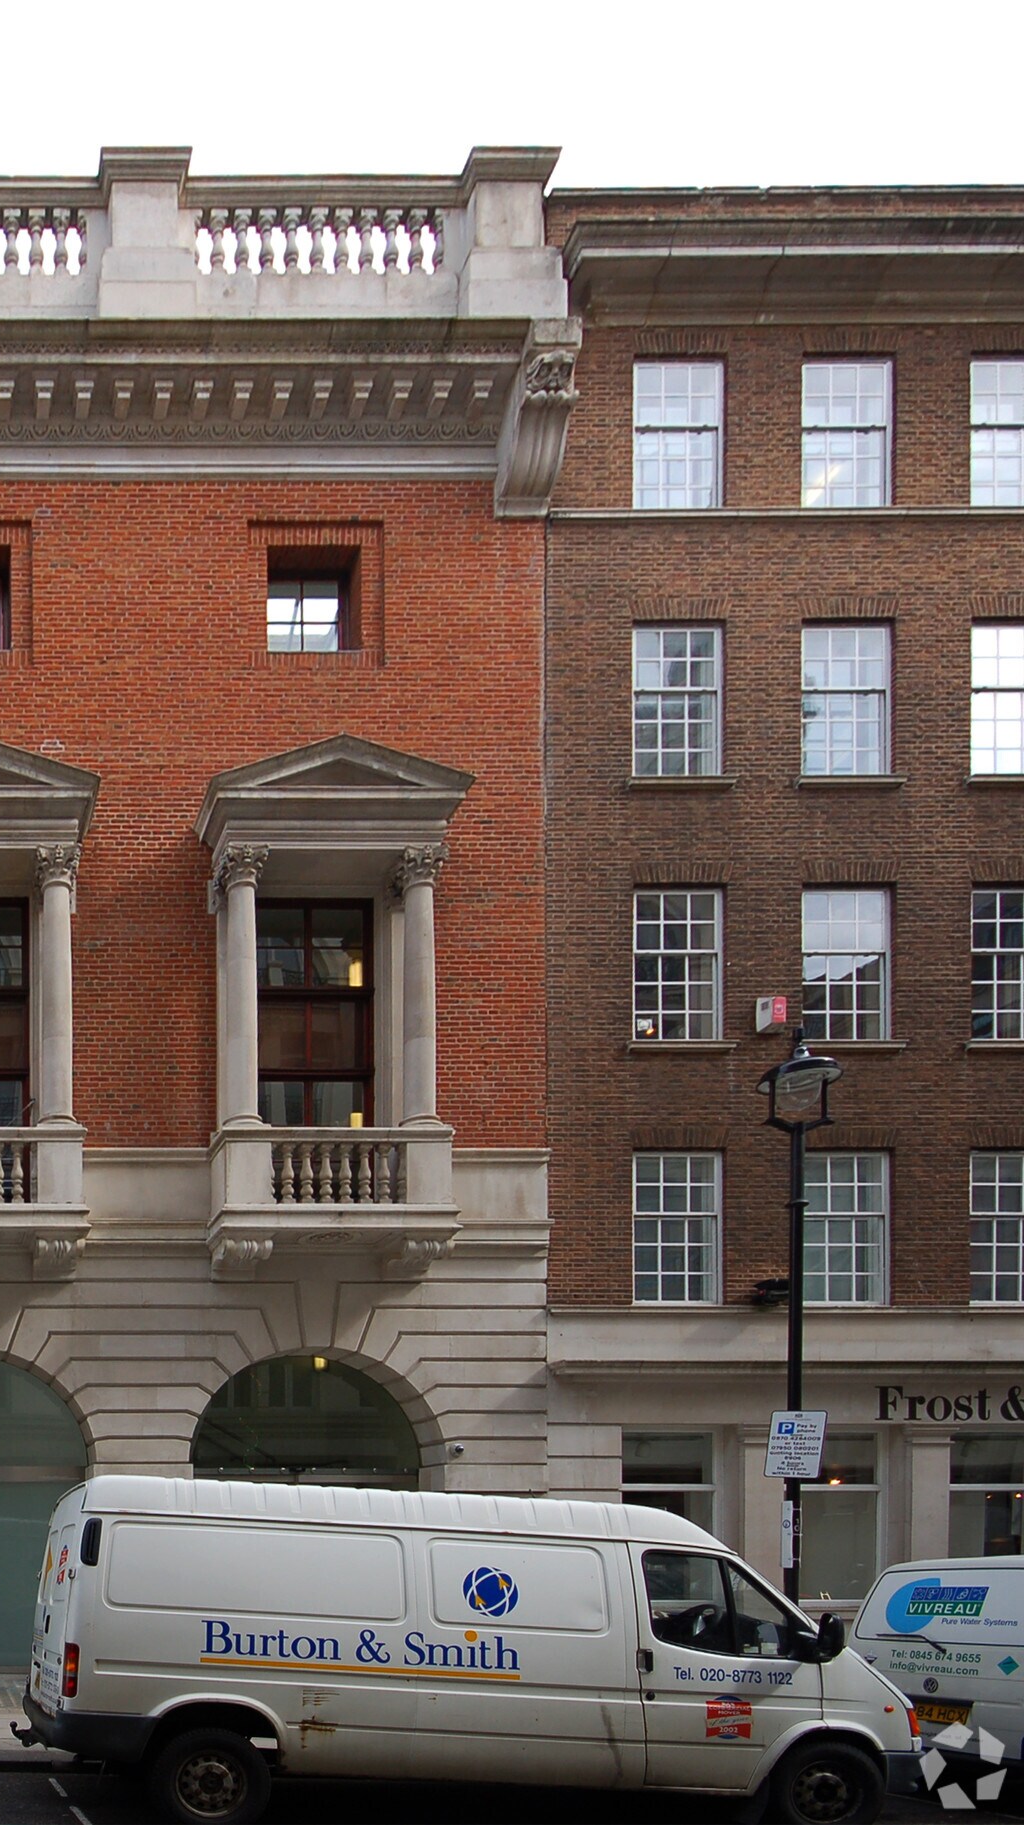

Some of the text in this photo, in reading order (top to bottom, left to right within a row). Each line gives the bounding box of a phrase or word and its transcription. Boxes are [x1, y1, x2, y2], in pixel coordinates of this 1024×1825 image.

[875, 1385, 1024, 1422] Frost &
[781, 1423, 793, 1433] P
[908, 1602, 977, 1615] VIVREAU
[960, 1618, 981, 1626] Water
[983, 1618, 1018, 1627] Systems
[200, 1619, 521, 1671] Burton & Smith
[891, 1649, 981, 1663] Tel: 0845 674 9655
[673, 1666, 793, 1685] Tel. 020-8773 1122
[889, 1661, 979, 1676] info@vivreau.com
[914, 1705, 933, 1719] 84
